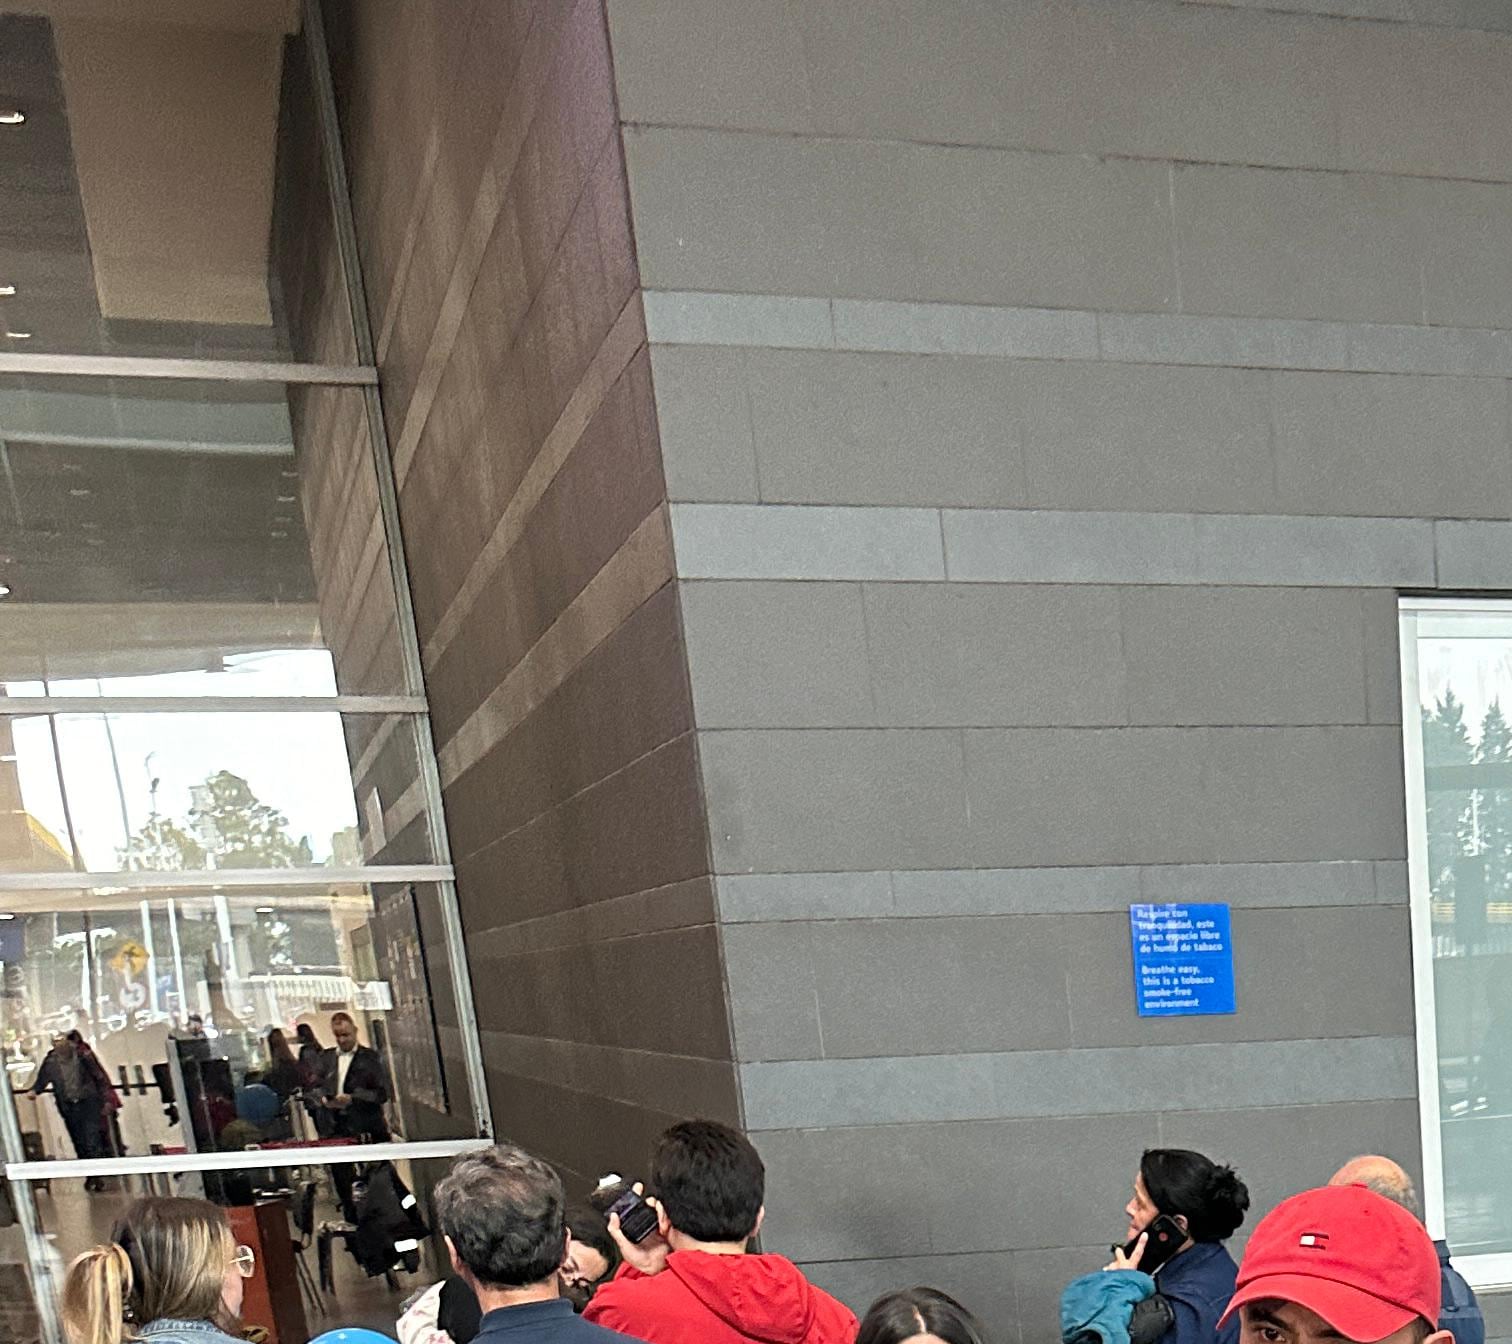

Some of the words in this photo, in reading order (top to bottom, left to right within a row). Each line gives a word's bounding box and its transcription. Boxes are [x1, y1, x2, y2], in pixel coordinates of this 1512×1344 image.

[1142, 965, 1177, 974] Breathe
[1163, 977, 1170, 985] is
[1144, 988, 1192, 997] smoke-free
